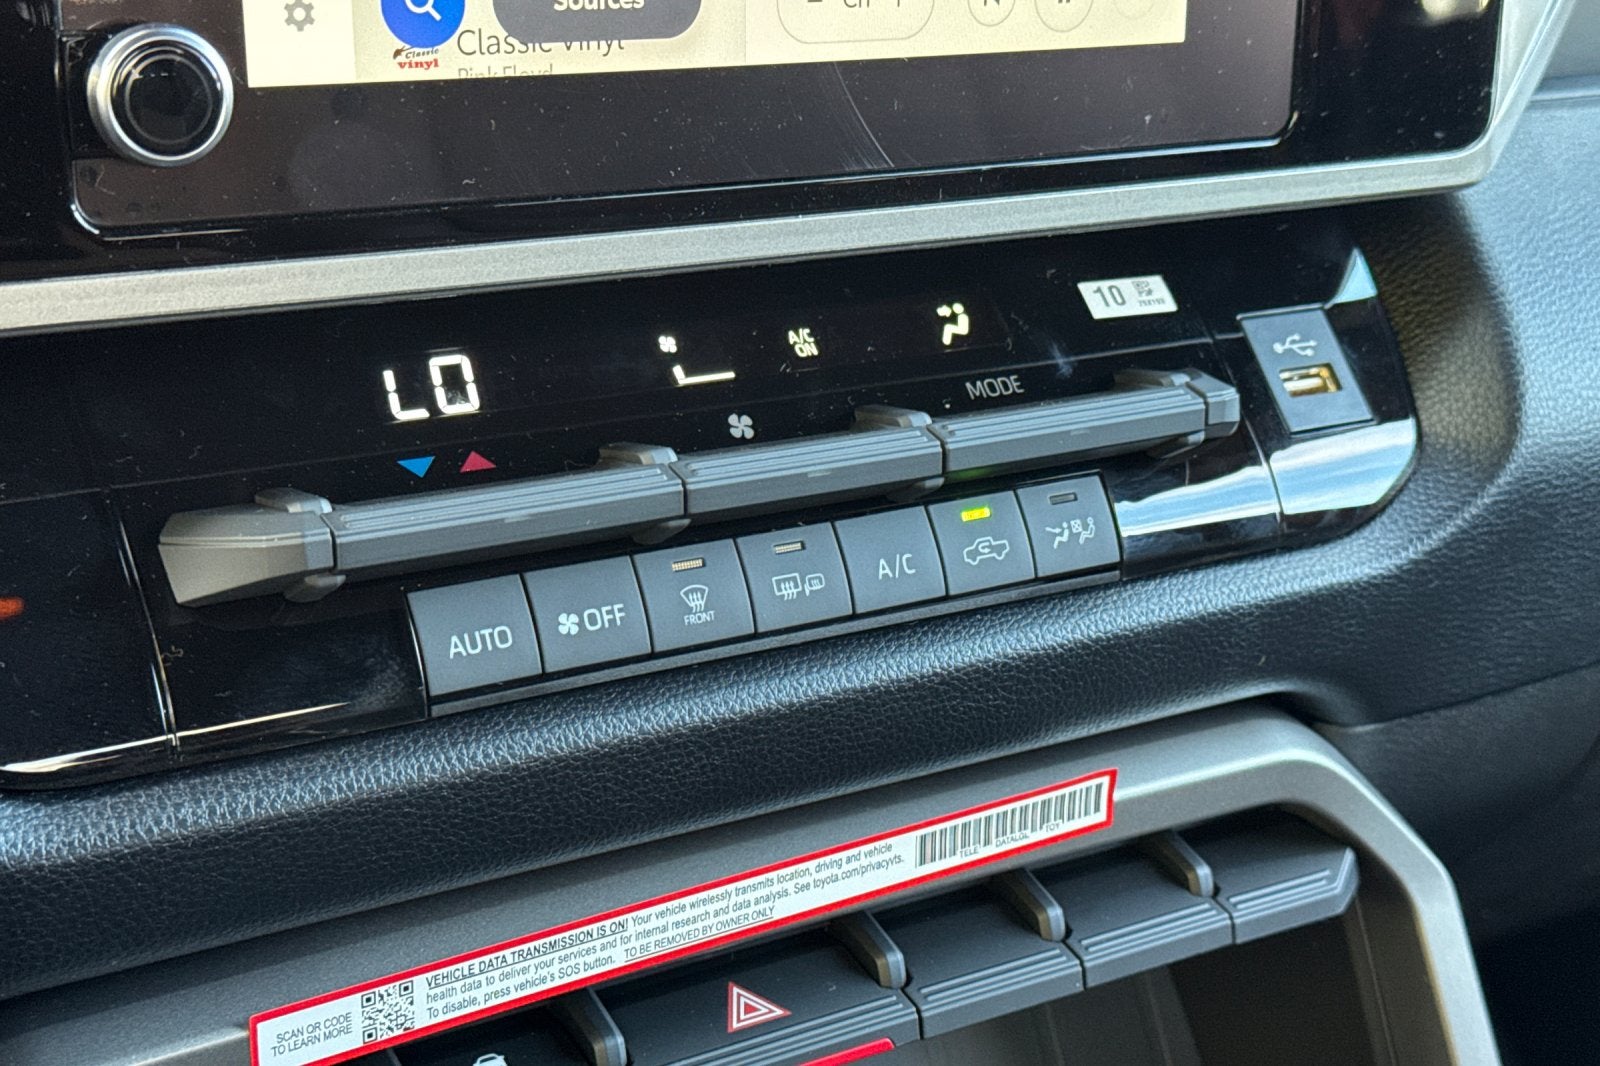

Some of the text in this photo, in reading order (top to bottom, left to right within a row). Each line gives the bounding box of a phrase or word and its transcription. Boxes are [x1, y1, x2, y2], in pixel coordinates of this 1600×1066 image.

[397, 59, 440, 70] vinyl
[1093, 285, 1126, 307] 10
[788, 328, 815, 345] A/C
[794, 343, 819, 358] ON
[965, 375, 1024, 400] MODE
[878, 553, 916, 579] A/C
[583, 604, 626, 632] OFF
[684, 610, 716, 626] FRONT
[448, 625, 513, 659] AUTO
[959, 846, 979, 858] TELE
[1045, 823, 1060, 833] TOY
[426, 842, 893, 988] VEHICLE DATA TRANSMISSION IS ON! Your vehicle wirelessly transmits location, driving and vehicle
[426, 854, 905, 1004] health data to deliver your services and for internal research and data analysis. See toyota.com/privacyvts.
[624, 905, 775, 959] TO BE REMOVED BY OWNER ONLY
[426, 955, 616, 1020] To disable, press vehicle's SOS button.
[271, 1024, 353, 1056] TO LEARN MORE
[276, 1012, 353, 1043] SCAN QR CODE
